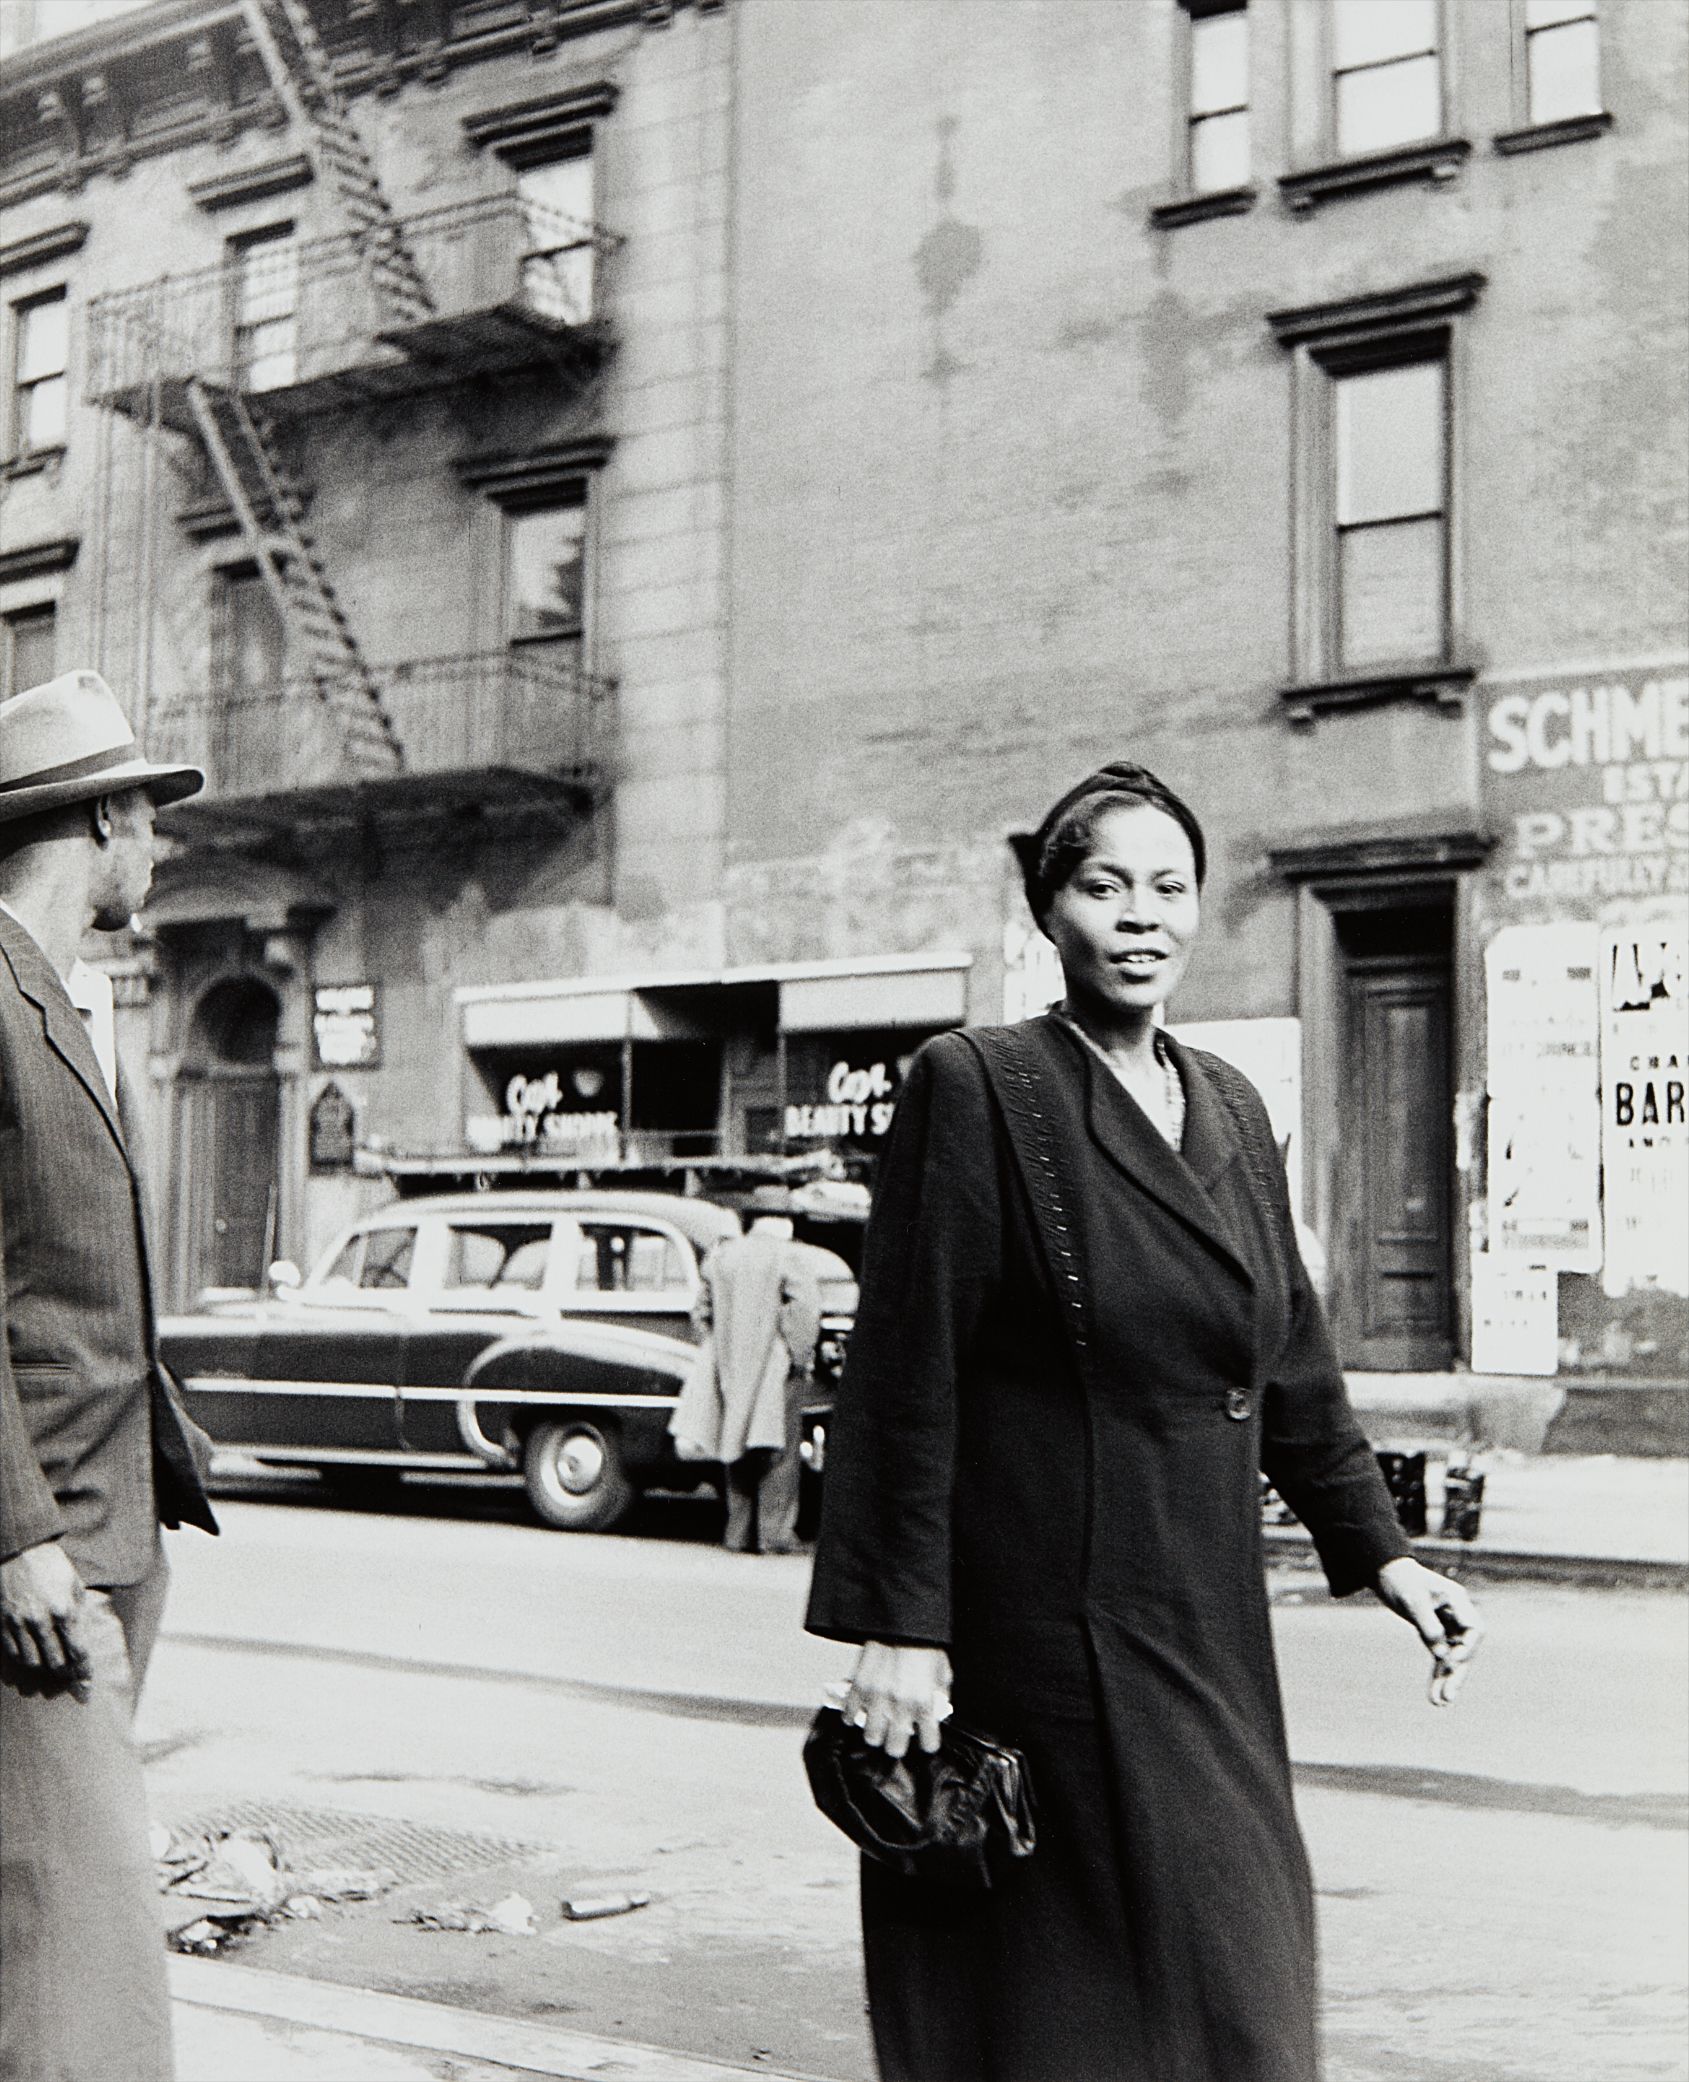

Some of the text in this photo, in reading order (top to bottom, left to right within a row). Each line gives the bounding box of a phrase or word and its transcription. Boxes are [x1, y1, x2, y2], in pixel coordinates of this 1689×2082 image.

[1629, 1054, 1689, 1071] CHA
[784, 1103, 868, 1137] BEAUTY
[1615, 1081, 1686, 1126] BAR
